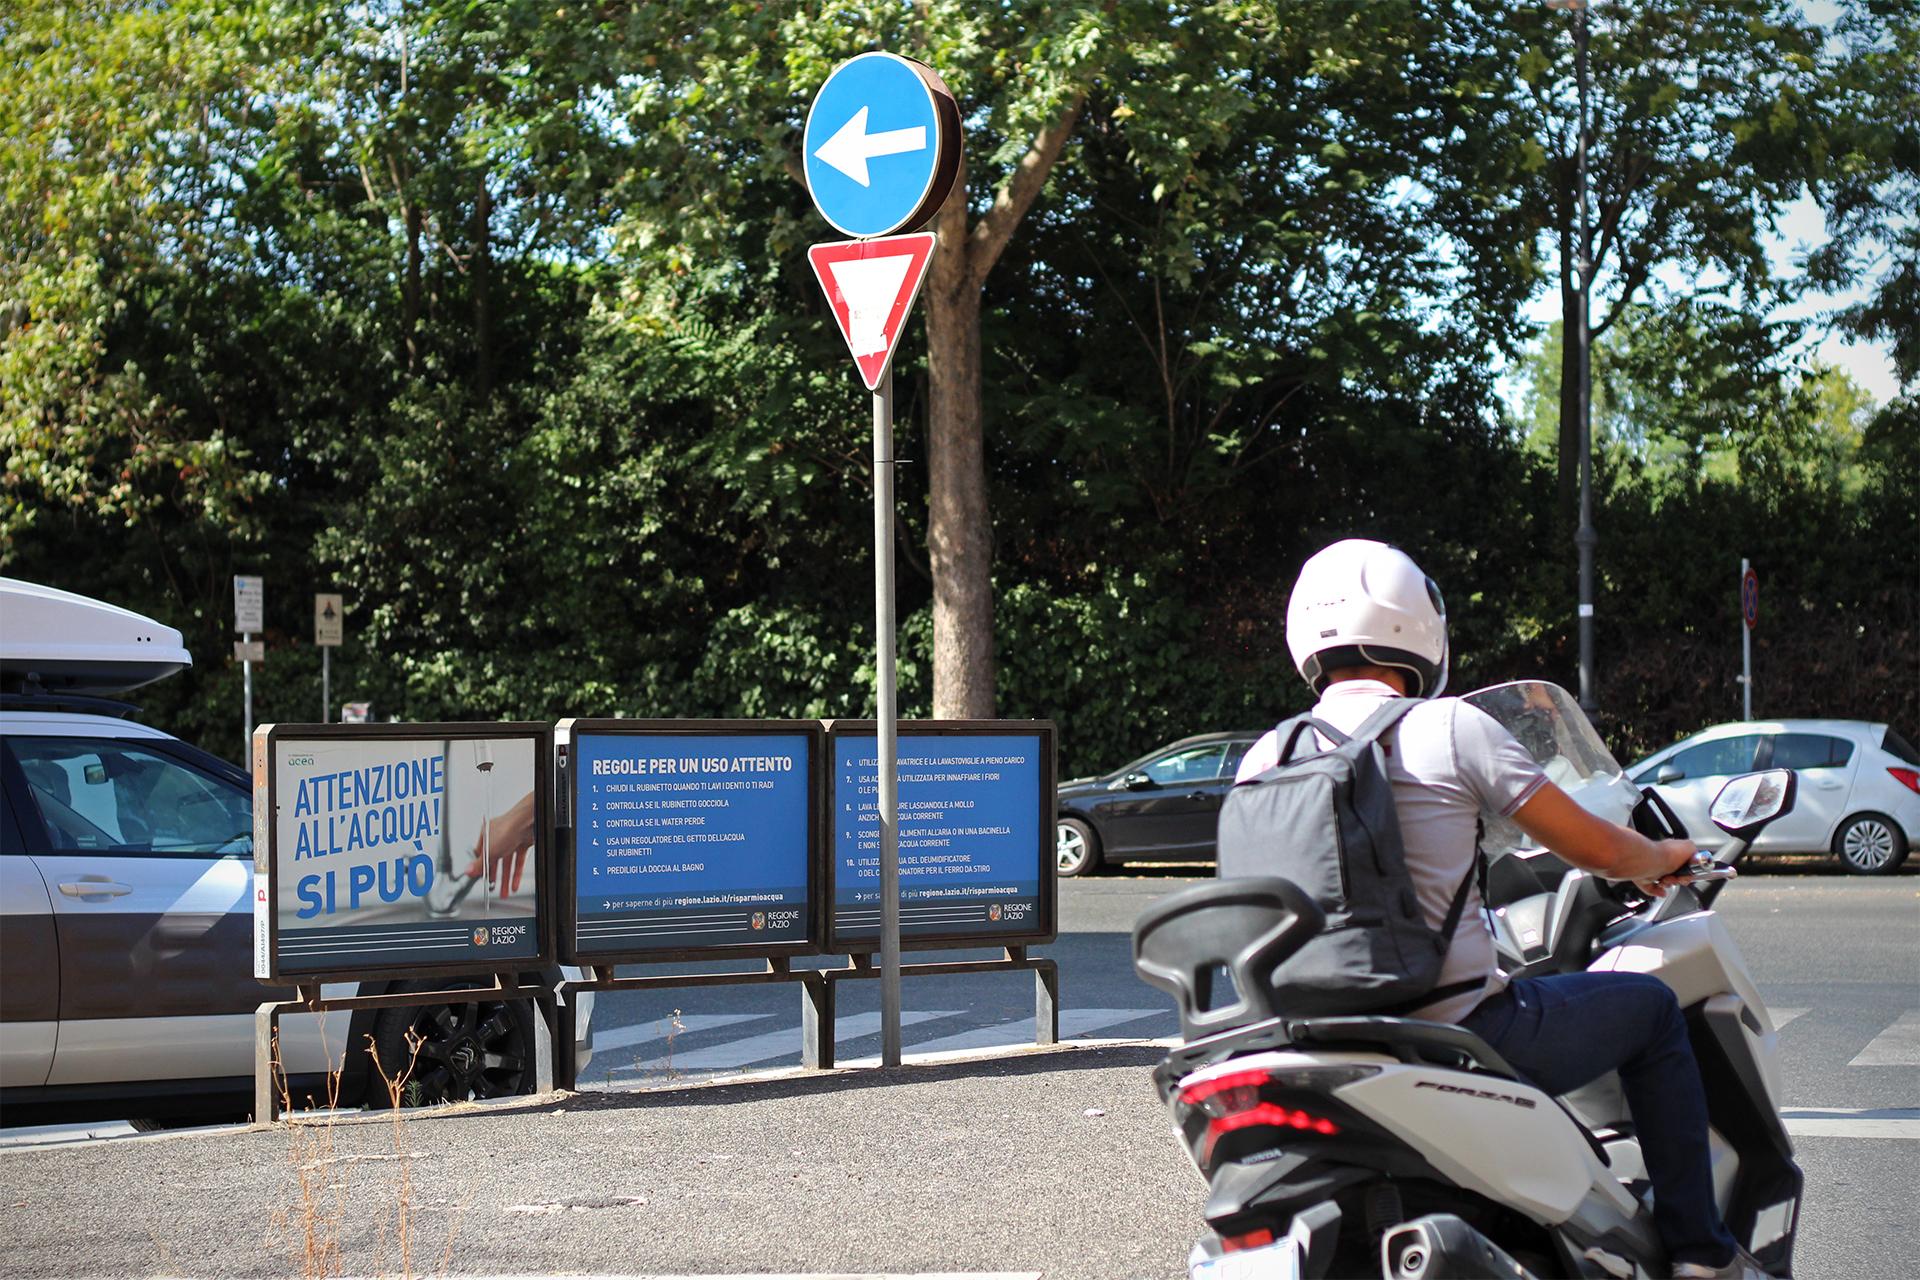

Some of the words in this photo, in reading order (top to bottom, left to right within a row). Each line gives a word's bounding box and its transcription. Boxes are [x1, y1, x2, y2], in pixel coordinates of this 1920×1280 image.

[593, 759, 646, 775] REGOLE
[649, 758, 676, 774] PER
[680, 758, 698, 773] UN
[702, 757, 728, 773] USO
[730, 756, 792, 772] ATTENTO
[896, 757, 924, 766] AVATRICE
[924, 758, 928, 766] E
[929, 757, 937, 765] LA
[937, 757, 979, 765] LAVASTOVIGLIE
[986, 756, 1003, 764] PIENO
[1004, 756, 1025, 764] CARICO
[858, 775, 870, 783] USA
[902, 774, 933, 783] UTILIZZATA
[934, 773, 945, 782] PER
[946, 773, 980, 781] INNAFFIARE
[985, 772, 1000, 781] FIORI
[294, 756, 444, 818] ATTENZIONE
[592, 785, 599, 793] 1.
[606, 784, 628, 793] CHIUDI
[629, 784, 635, 792] IL
[636, 783, 672, 792] RUBINETTO
[673, 782, 700, 792] QUANDO
[701, 782, 707, 790] TI
[707, 782, 721, 790] LAVI
[725, 781, 745, 790] DENTI
[745, 781, 751, 789] O
[752, 781, 758, 789] TI
[759, 780, 774, 789] RADI
[864, 786, 871, 794] LE
[592, 803, 599, 811] 2.
[606, 801, 644, 810] CONTROLLA
[645, 801, 653, 809] SE
[654, 800, 660, 809] IL
[661, 799, 697, 809] RUBINETTO
[698, 799, 729, 808] GOCCIOLA
[858, 803, 873, 811] LAVA
[909, 801, 948, 810] LASCIANDOLE
[954, 800, 975, 808] MOLLO
[858, 813, 880, 822] ANZICH
[913, 811, 944, 820] CORRENTE
[592, 820, 599, 828] 3.
[606, 819, 644, 828] CONTROLLA
[645, 818, 653, 827] SE
[654, 818, 660, 826] IL
[661, 817, 683, 826] WATER
[684, 817, 705, 825] PERDE
[294, 798, 440, 861] ALL'ACQUA!
[857, 830, 880, 839] SCONGE
[899, 829, 927, 837] ALIMENTI
[927, 828, 952, 836] ALL'ARIA
[957, 827, 964, 835] IN
[964, 827, 978, 835] UNA
[978, 827, 1011, 835] BACINELLA
[592, 838, 599, 846] 4.
[606, 837, 620, 846] USA
[620, 836, 630, 845] UN
[631, 835, 672, 845] REGOLATORE
[673, 835, 685, 843] DEL
[686, 834, 707, 843] GETTO
[707, 833, 745, 842] DELL'ACQUA
[858, 841, 862, 850] E
[862, 841, 876, 849] NON
[919, 839, 950, 848] CORRENTE
[606, 848, 618, 857] SUI
[618, 847, 652, 857] RUBINETTI
[858, 857, 880, 866] UTILIZZ
[907, 856, 920, 865] DEL
[920, 854, 972, 864] DEUMIDIFICATORE
[593, 867, 600, 875] 5.
[607, 866, 639, 875] PREDILIGI
[640, 865, 648, 874] LA
[648, 864, 672, 873] DOCCIA
[672, 864, 681, 872] AL
[682, 863, 704, 872] BAGNO
[864, 869, 875, 877] DEL
[926, 866, 937, 875] PER
[938, 866, 944, 874] IL
[944, 865, 964, 874] FERRO
[965, 865, 973, 873] DA
[974, 864, 991, 873] STIRO
[295, 870, 336, 919] SI
[350, 840, 434, 910] PUÒ
[863, 893, 874, 901] per
[919, 886, 1018, 898] regione.lazio.it/risparmioacqua
[612, 901, 624, 910] per
[625, 900, 653, 909] saperne
[654, 897, 661, 906] di
[662, 897, 673, 907] più
[674, 893, 783, 906] regione.lazio.it/risparmioacqua
[1003, 903, 1032, 912] REGIONE
[768, 910, 799, 920] REGIONE
[1003, 911, 1024, 920] LAZIO
[492, 925, 526, 935] REGIONE
[768, 920, 790, 929] LAZIO
[492, 935, 516, 945] LAZIO
